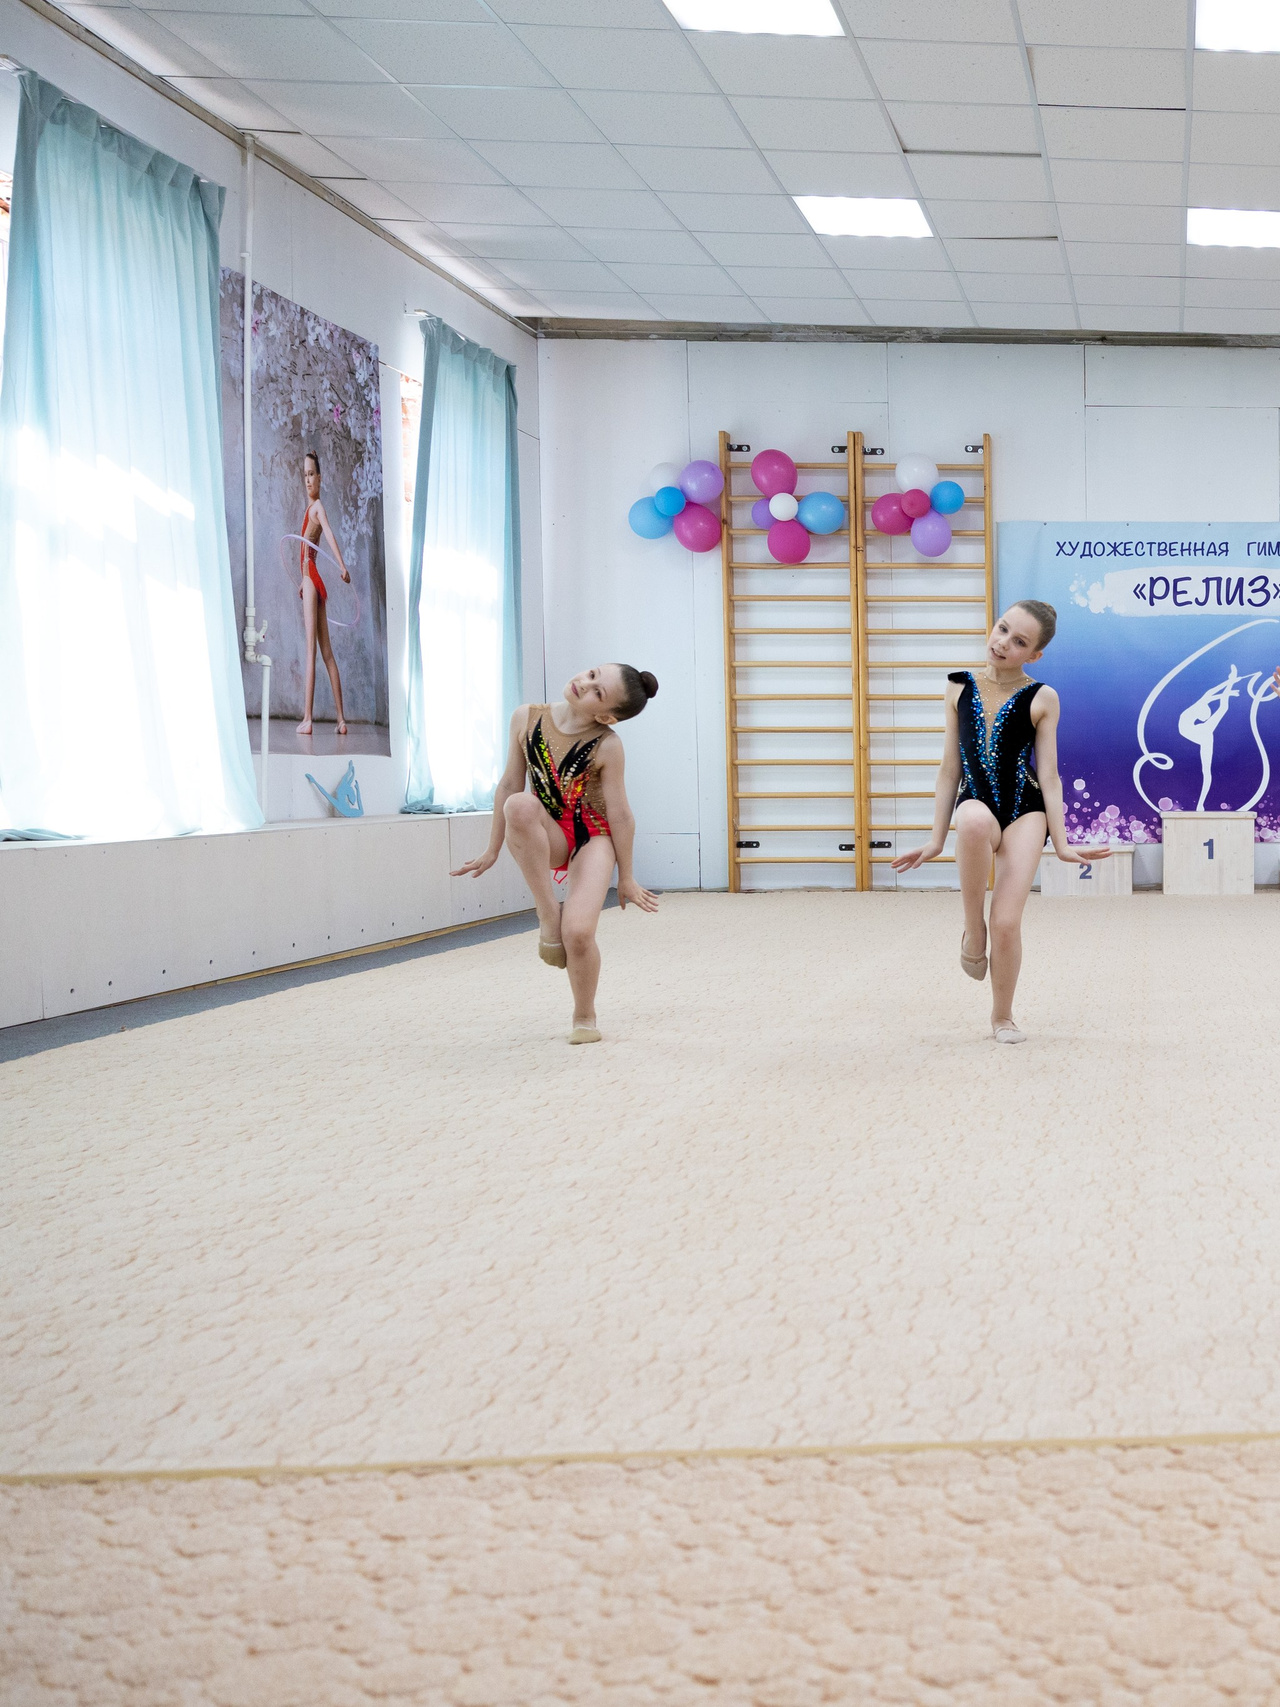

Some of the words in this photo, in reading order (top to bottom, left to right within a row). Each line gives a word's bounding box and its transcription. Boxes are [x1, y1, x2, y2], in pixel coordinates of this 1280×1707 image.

[1055, 540, 1230, 559] ХУДОЖЕСТВЕННАЯ
[1203, 838, 1214, 860] 1
[1079, 863, 1092, 880] 2
